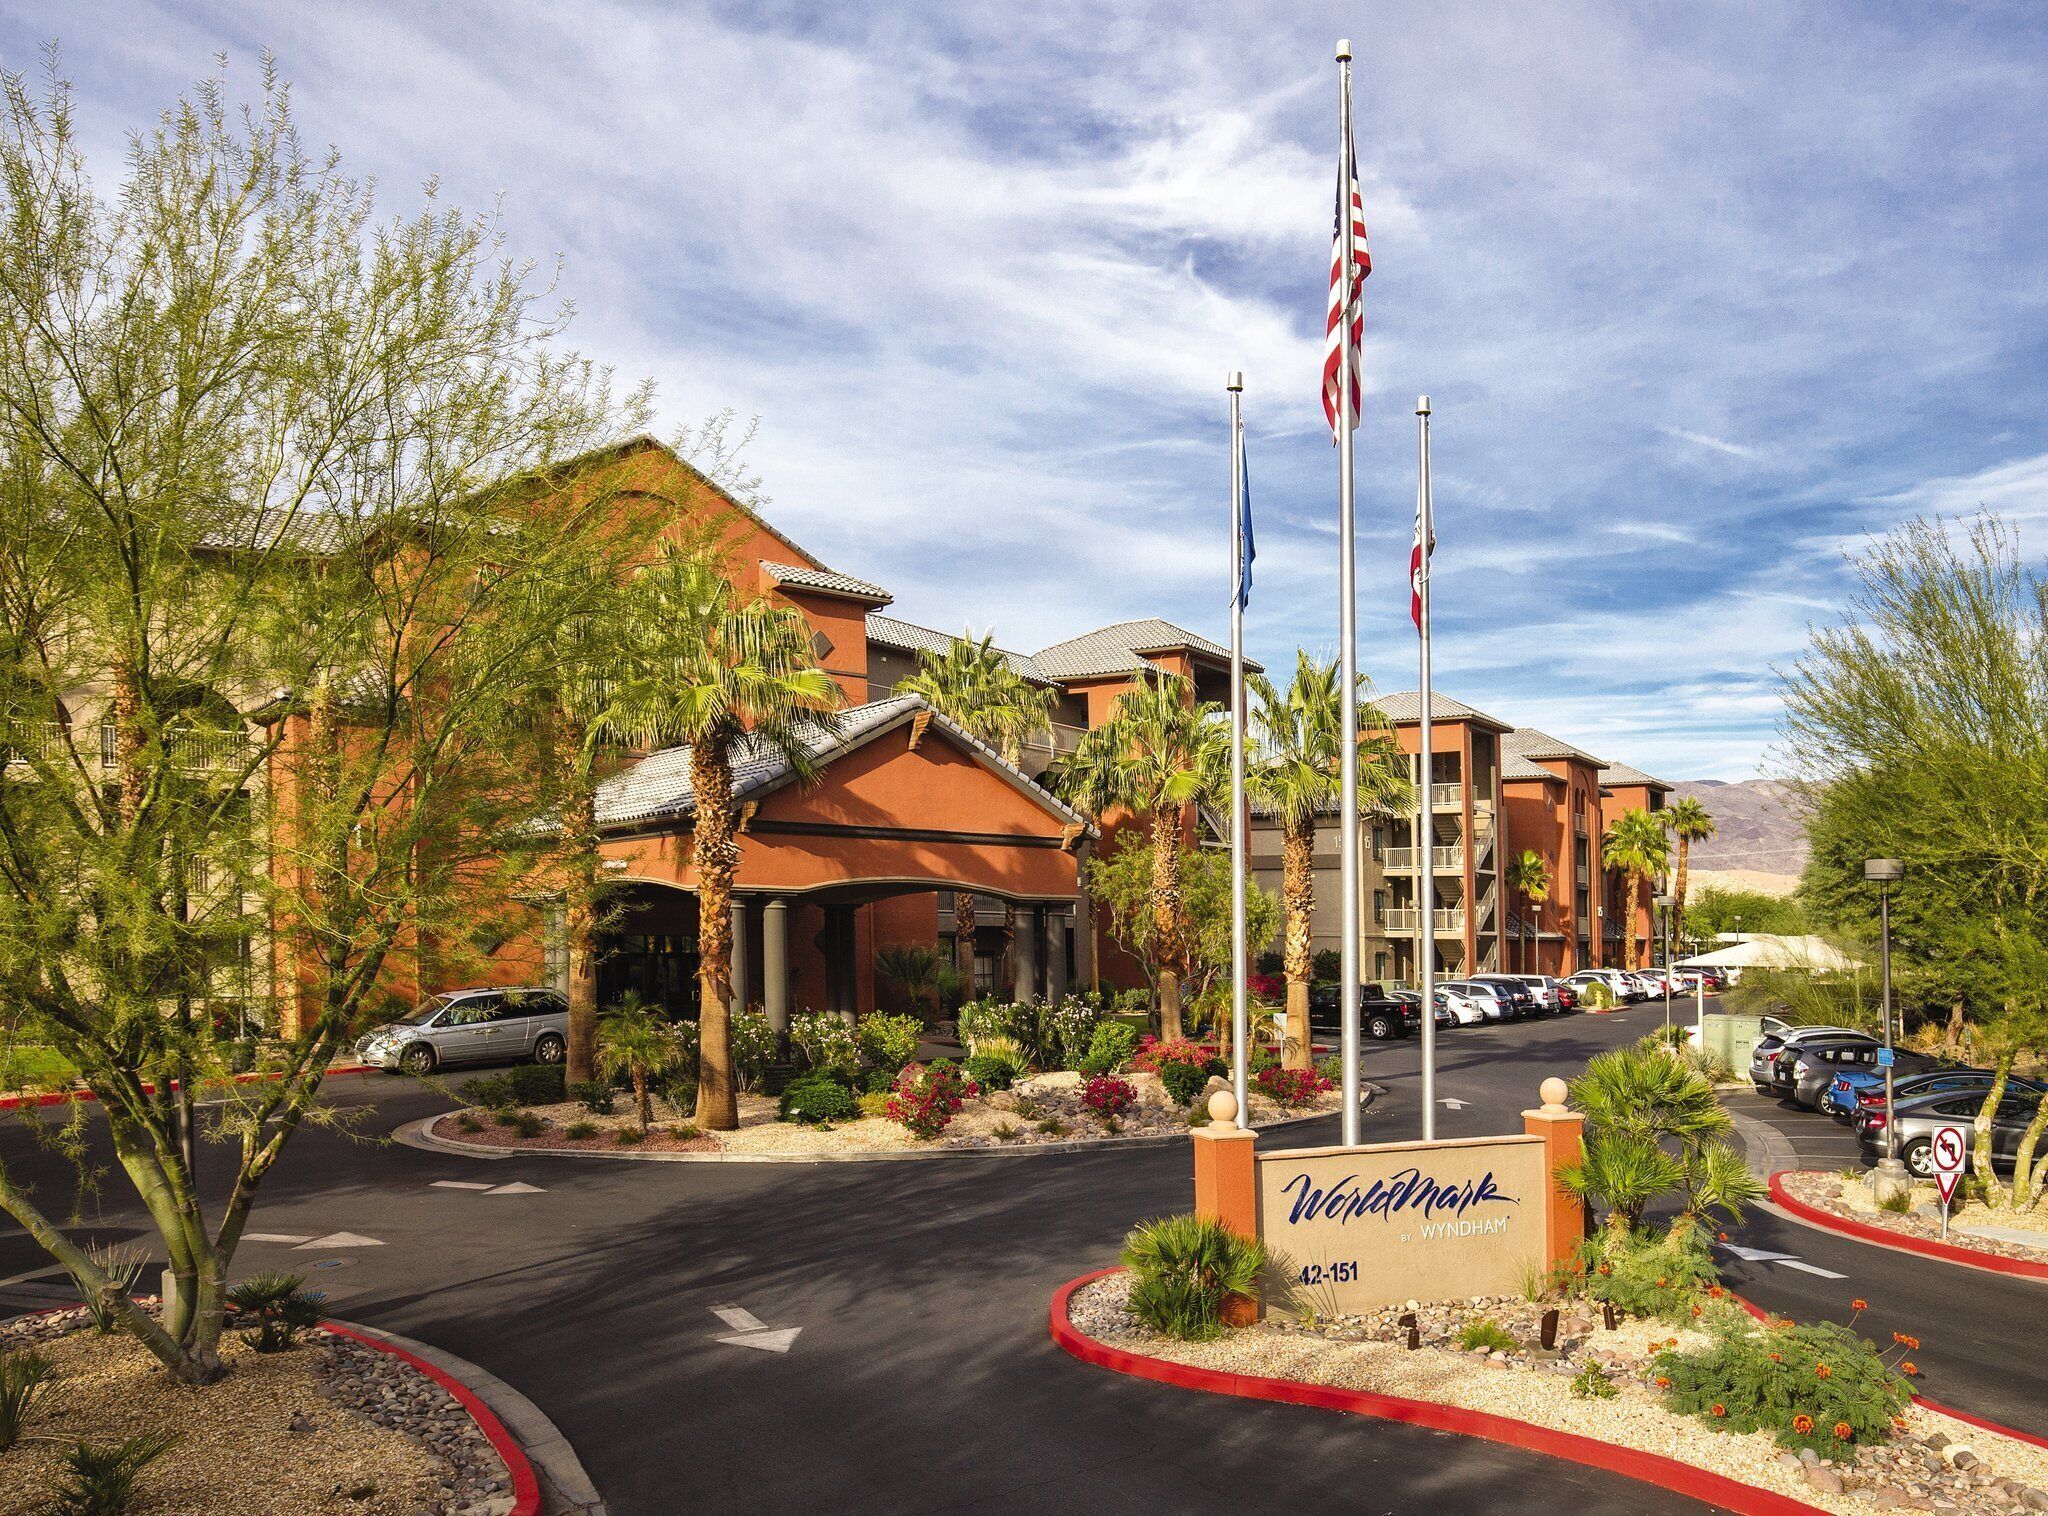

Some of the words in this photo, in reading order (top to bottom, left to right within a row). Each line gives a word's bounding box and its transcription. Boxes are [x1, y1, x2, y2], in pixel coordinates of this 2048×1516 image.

[1281, 1168, 1519, 1225] WorldMark
[1401, 1233, 1412, 1243] BY
[1420, 1218, 1507, 1240] WYNDHAM
[1299, 1261, 1358, 1285] 42-151
